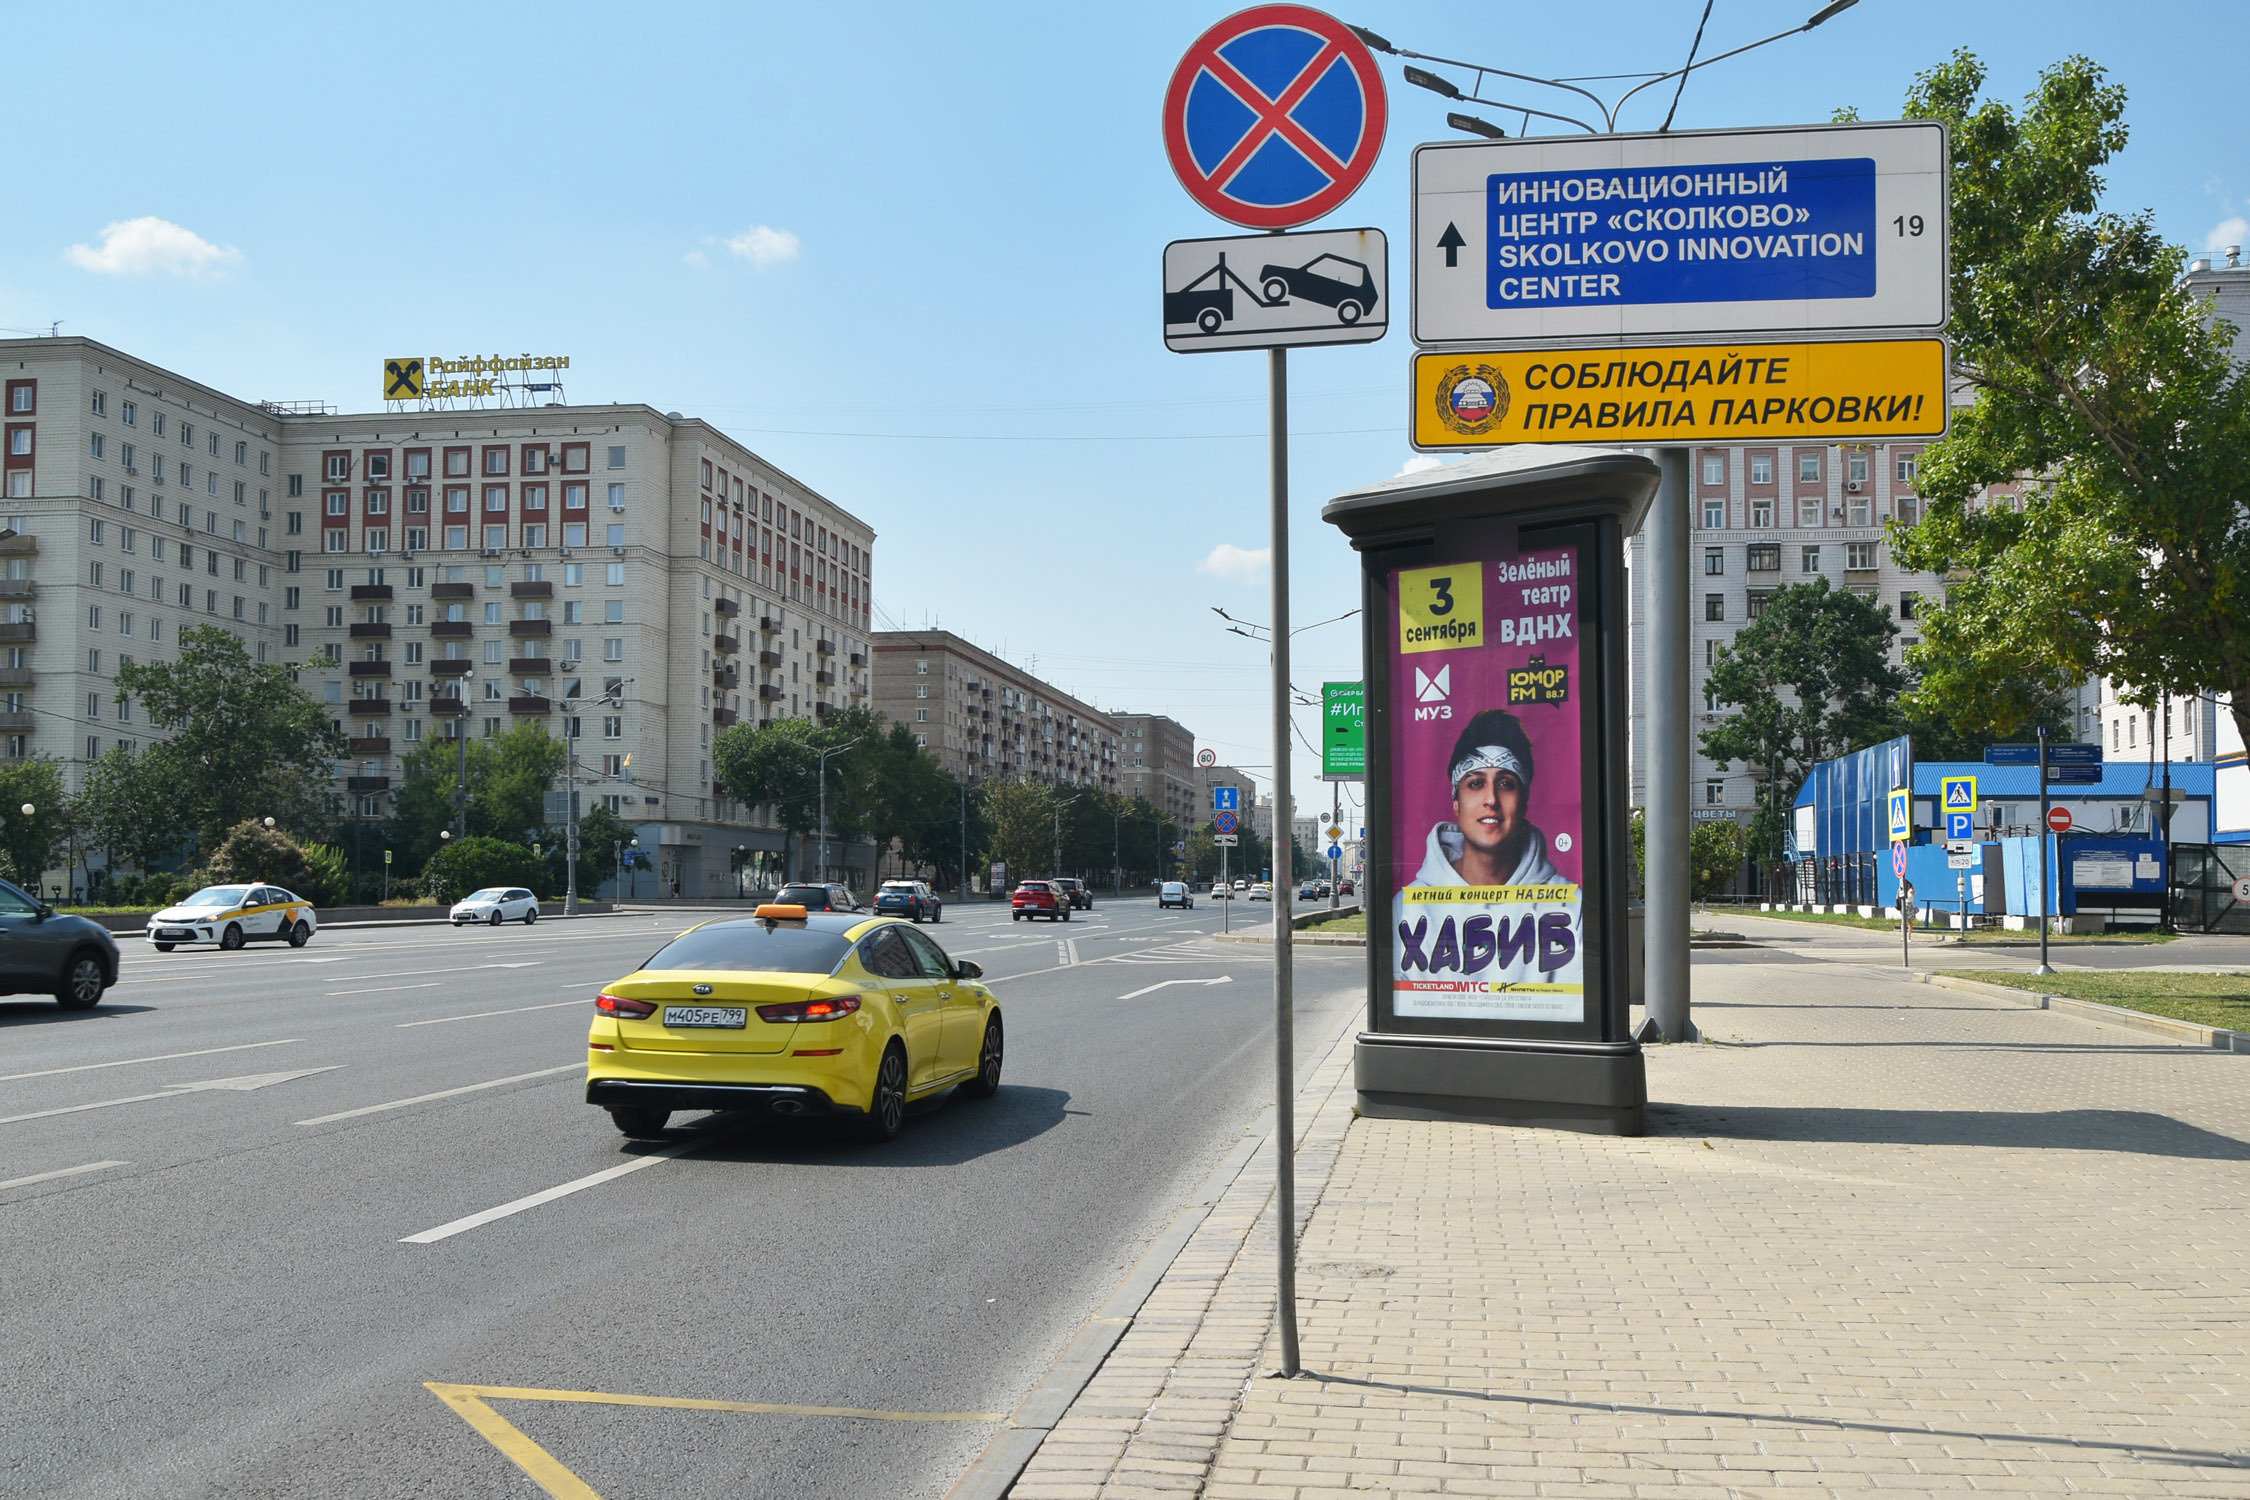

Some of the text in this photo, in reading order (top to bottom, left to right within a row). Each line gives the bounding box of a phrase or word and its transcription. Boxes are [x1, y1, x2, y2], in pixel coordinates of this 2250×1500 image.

[1499, 166, 1788, 205] ИННОВАЦИОННЫЙ
[1499, 203, 1811, 240] ЦЕНТР «СКОЛКОВО»
[1893, 215, 1925, 238] 19
[1499, 233, 1864, 268] SKOLKOVO INNOVATION
[1499, 273, 1621, 300] CENTER
[429, 353, 569, 376] Райффайзен
[1524, 353, 1790, 394] СОБЛЮДАЙТЕ
[429, 378, 498, 398] БАНК
[1523, 395, 1924, 430] ПРАВИЛА ПАРКОВКИ!
[1498, 553, 1571, 583] Зелёный
[1429, 577, 1454, 616] 3
[1521, 584, 1571, 608] театр
[1406, 619, 1476, 643] сентября
[1501, 613, 1572, 647] ВДНХ
[1510, 669, 1565, 688] ЮМОР
[1510, 687, 1536, 701] FM
[1545, 690, 1565, 699] 88.7
[1415, 705, 1452, 721] МУЗ
[1201, 754, 1212, 762] 80
[1558, 837, 1568, 848] 0+
[1411, 889, 1568, 902] летний концерт НА БИС!
[2242, 884, 2249, 896] 5
[1399, 912, 1576, 976] ХАБИБ
[1412, 982, 1455, 990] TICKETLAND
[1457, 981, 1489, 993] МТС
[721, 1009, 742, 1020] 799
